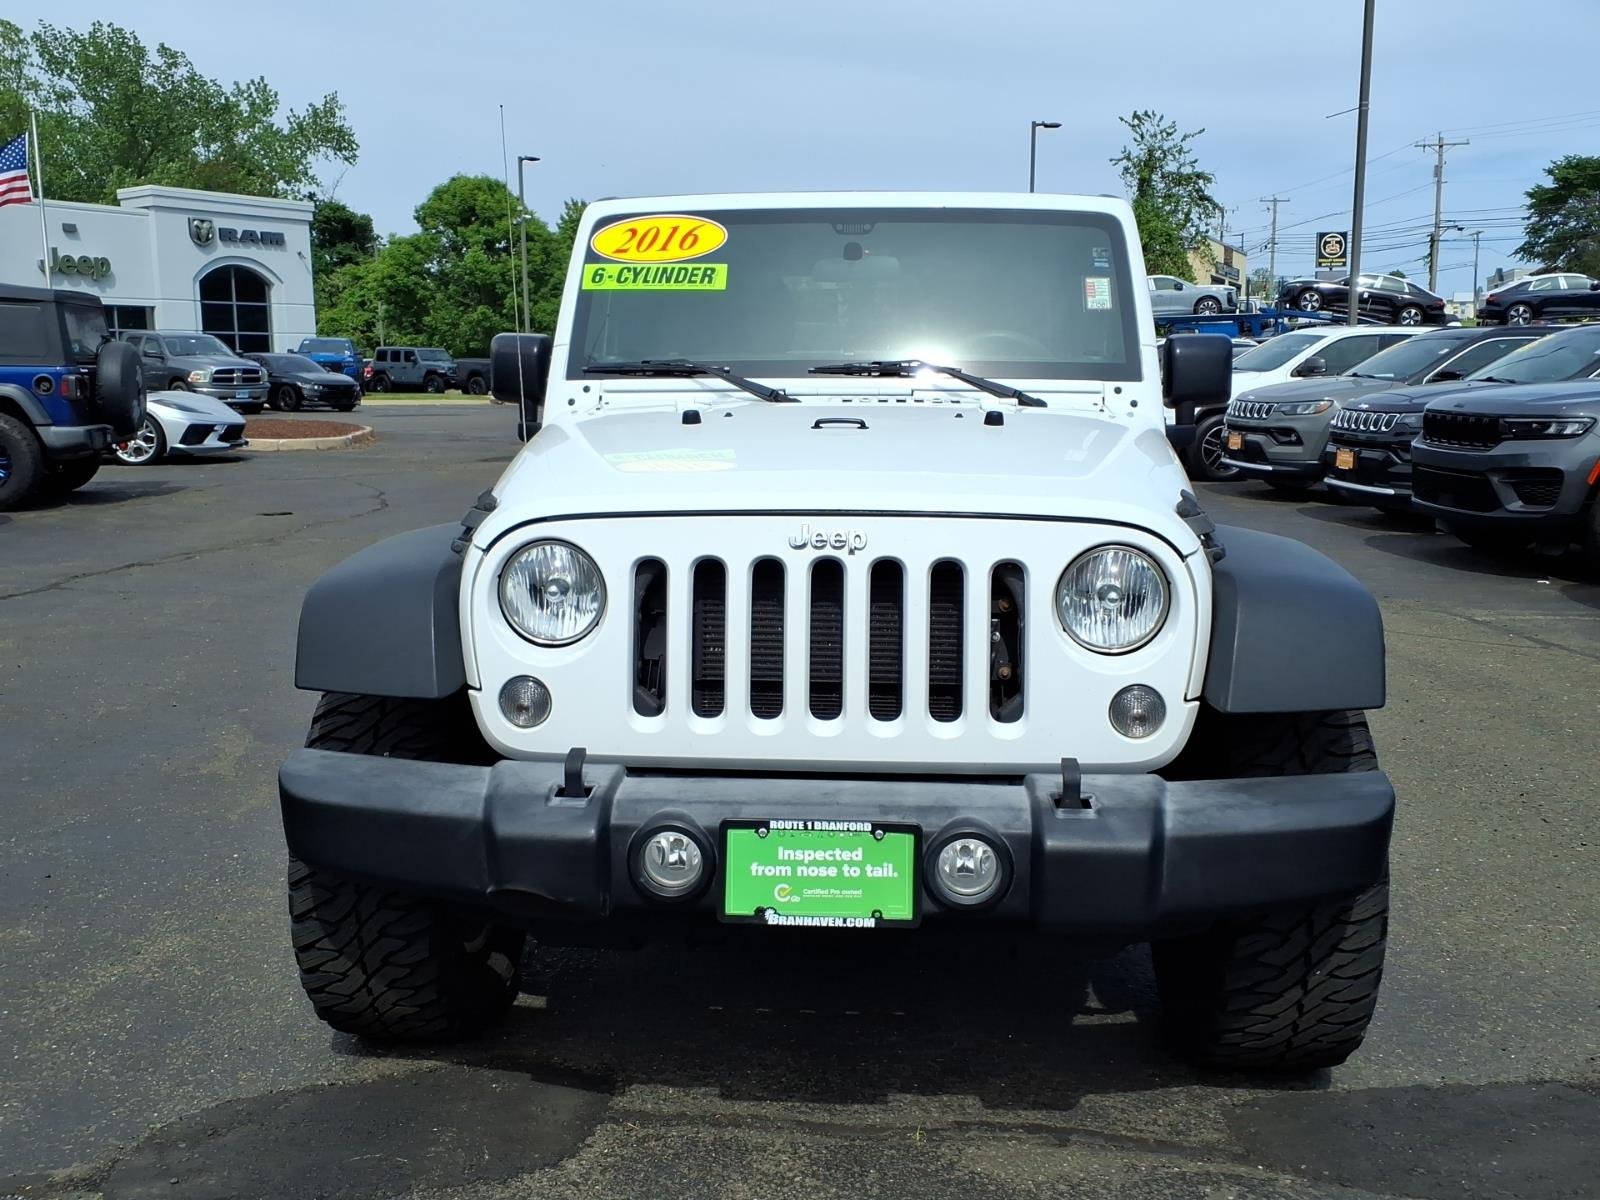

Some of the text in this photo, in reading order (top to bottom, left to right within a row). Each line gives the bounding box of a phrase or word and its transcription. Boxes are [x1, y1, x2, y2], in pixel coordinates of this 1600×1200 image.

[218, 227, 286, 247] RAM
[611, 223, 707, 254] 2016
[37, 246, 112, 281] Jeep
[591, 266, 717, 287] 6-CYLINDER
[788, 524, 868, 556] Jeep
[769, 820, 873, 832] ROUTE 1 BRANFORD
[777, 846, 864, 863] Inspected
[750, 862, 899, 878] from nose to tail.
[802, 887, 829, 895] Certified
[767, 913, 876, 929] BRANHAVEN.COM
